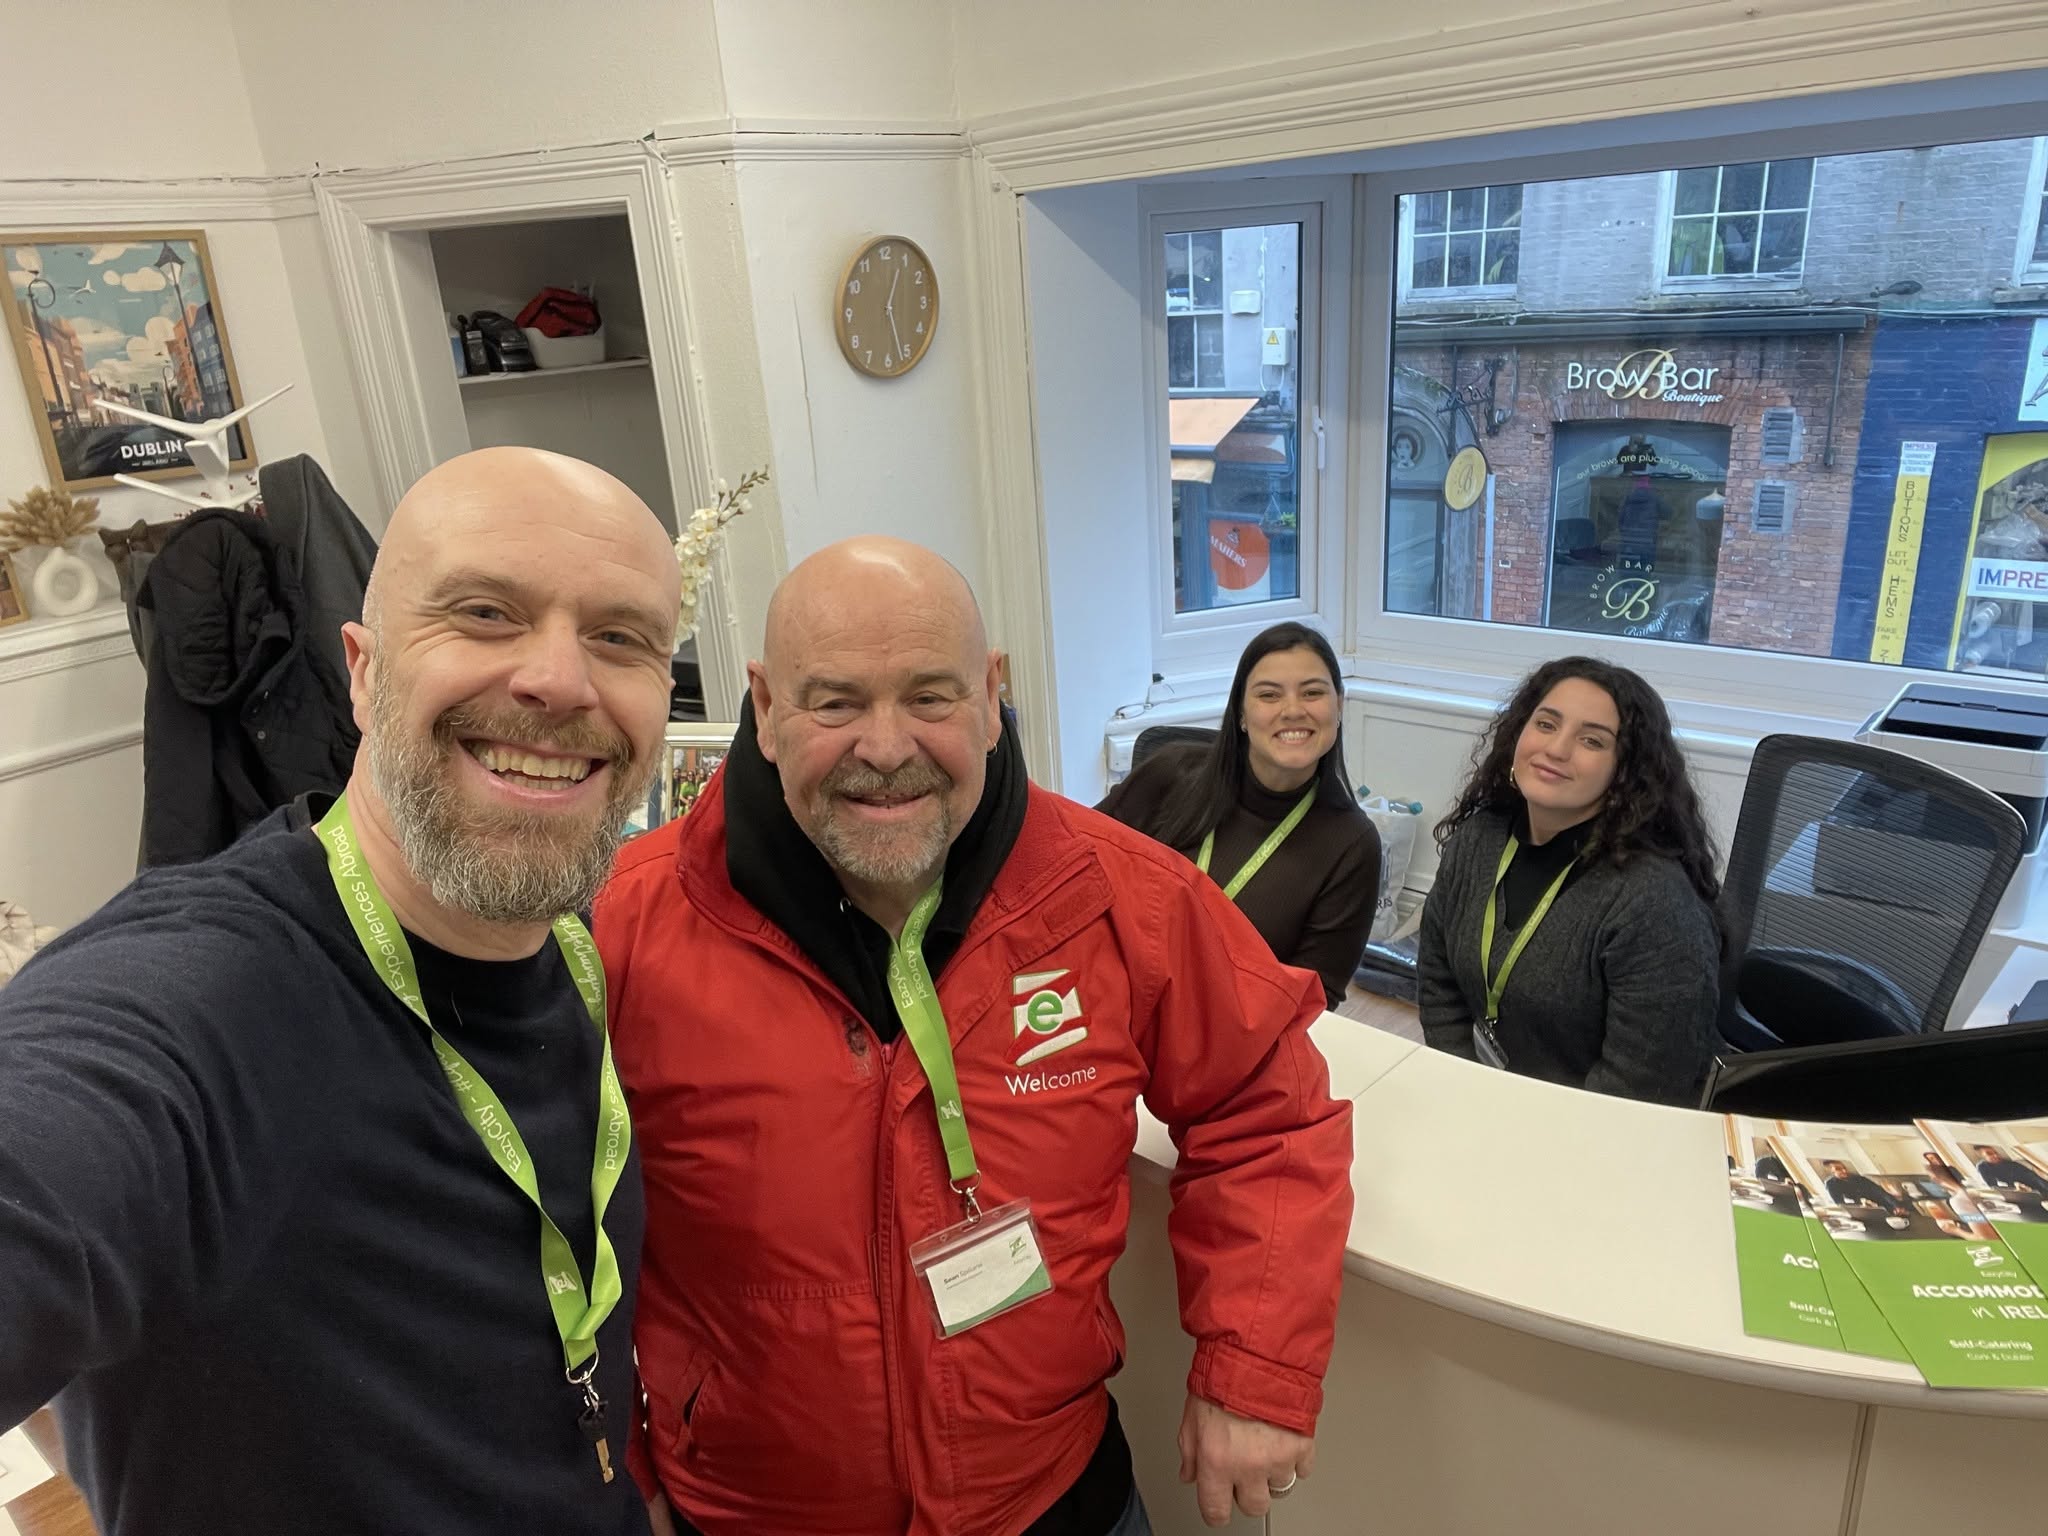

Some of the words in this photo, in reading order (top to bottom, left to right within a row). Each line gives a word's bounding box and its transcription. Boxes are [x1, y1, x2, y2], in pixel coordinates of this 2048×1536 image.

[879, 246, 891, 260] 12
[902, 253, 908, 267] 1
[860, 257, 870, 272] 11
[915, 271, 923, 284] 2
[849, 280, 860, 294] 10
[920, 296, 927, 309] 3
[845, 308, 852, 323] 9
[916, 321, 923, 333] 4
[852, 335, 859, 348] 8
[866, 350, 872, 364] 7
[904, 344, 911, 357] 5
[884, 353, 892, 368] 6
[1662, 389, 1724, 407] Boutique
[121, 440, 183, 459] DUBLIN
[1620, 454, 1636, 463] are
[1638, 453, 1680, 470] plucking
[1898, 480, 1915, 543] BUTTONS
[1590, 564, 1615, 599] BROW
[1625, 560, 1652, 573] BAR
[1978, 567, 2048, 589] IMPRE
[1601, 577, 1660, 622] B
[1885, 575, 1900, 618] HEMS
[327, 824, 362, 878] Abroad
[351, 881, 406, 992] Experiences
[907, 949, 931, 1000] Abroad
[1005, 1066, 1097, 1097] Welcome
[475, 1104, 522, 1174] EazyCity
[604, 1108, 625, 1170] Abroad
[1998, 1304, 2048, 1320] IREL
